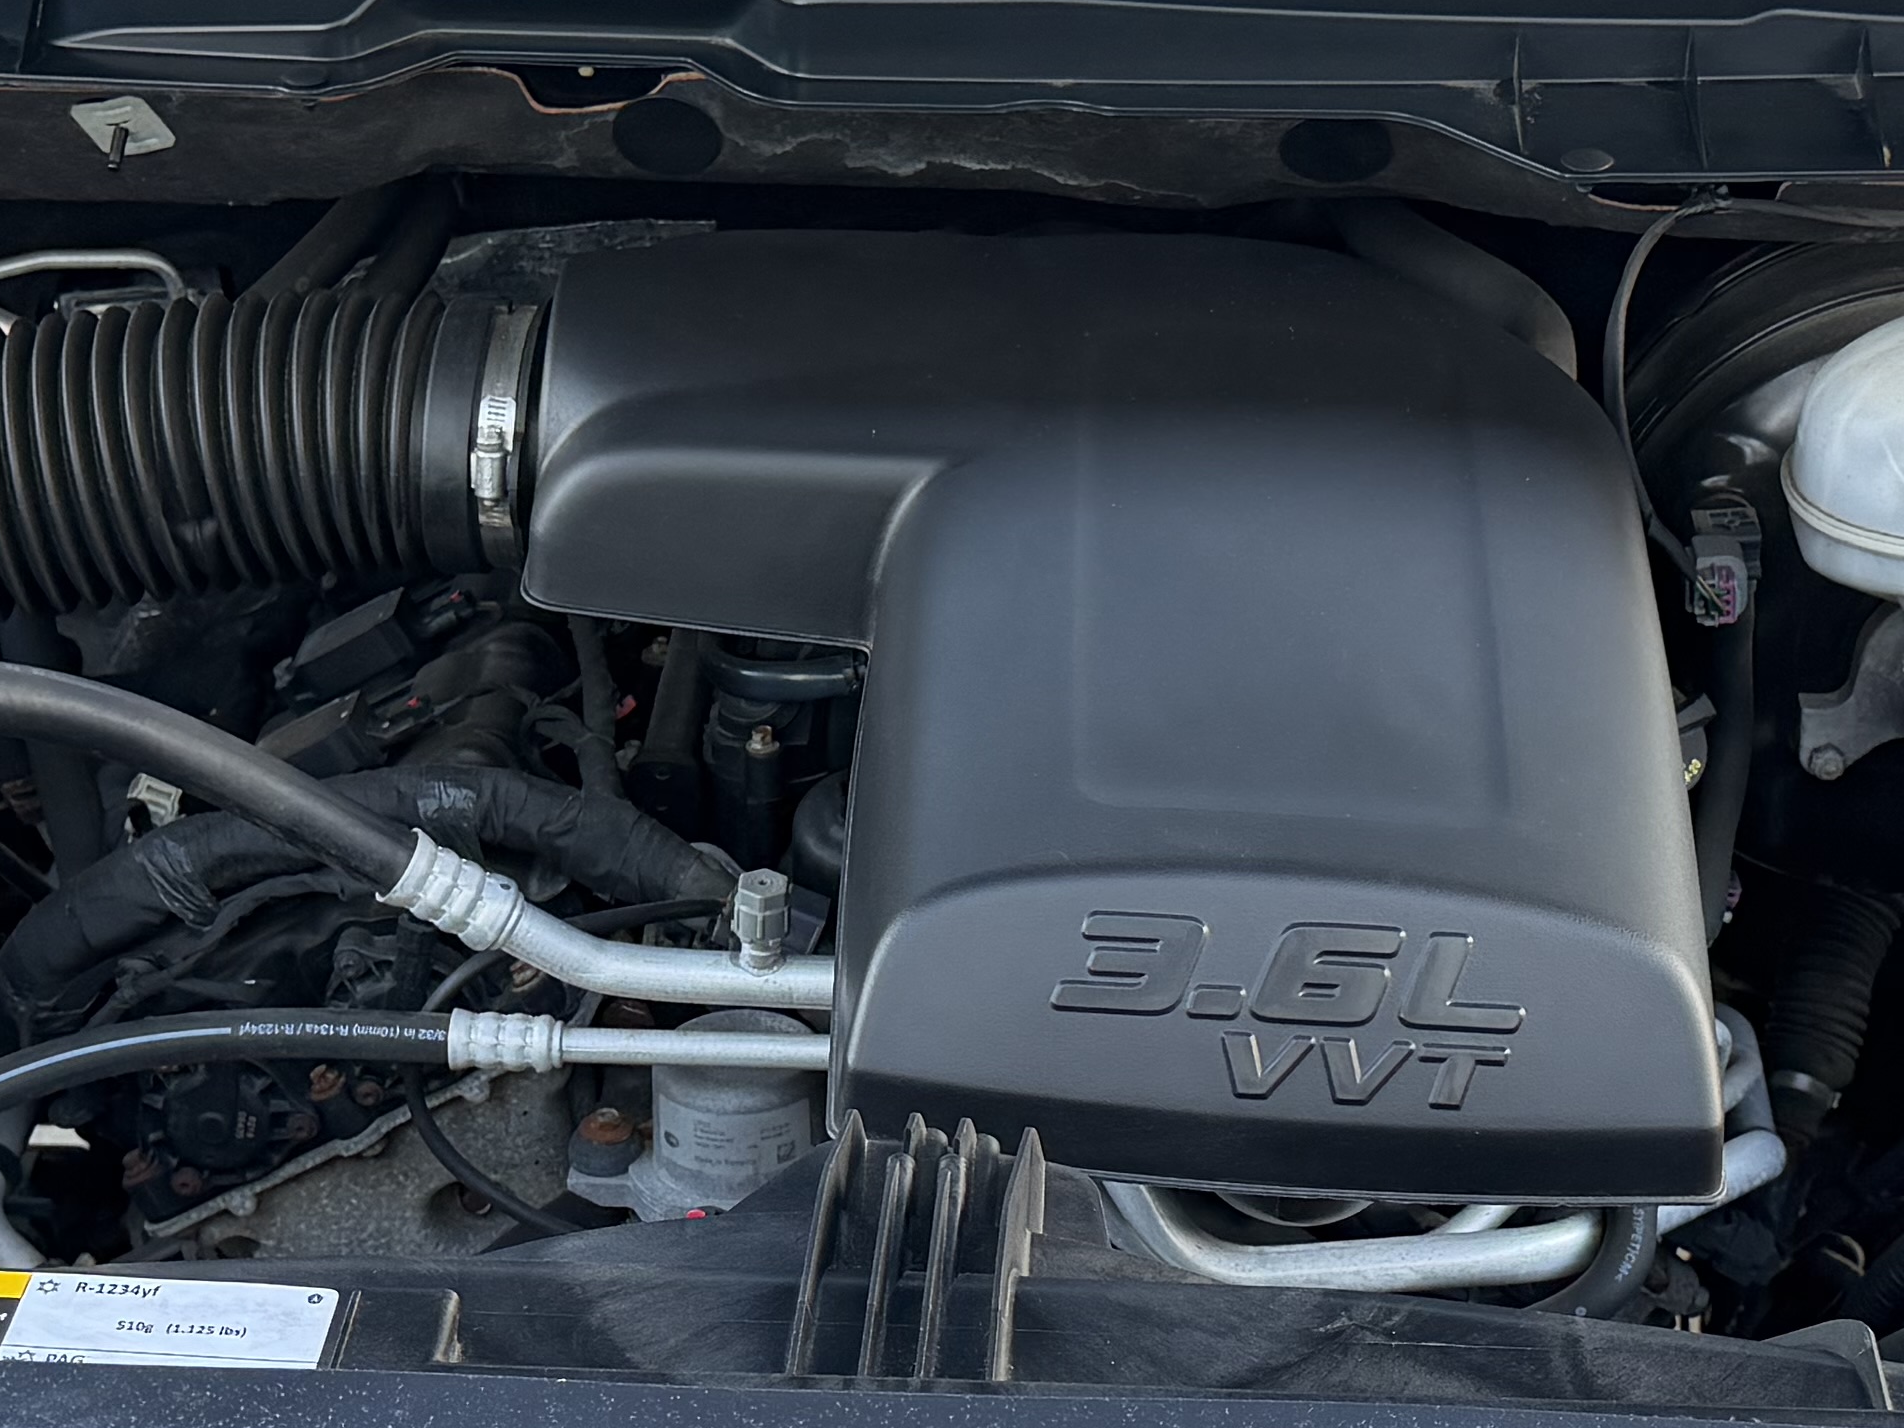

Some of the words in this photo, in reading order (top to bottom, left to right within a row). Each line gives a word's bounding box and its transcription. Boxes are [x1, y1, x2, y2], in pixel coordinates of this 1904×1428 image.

[1050, 909, 1528, 1033] 3.6L
[304, 1022, 350, 1037] R-134a
[352, 1022, 401, 1039] (10mm)
[1219, 1030, 1512, 1111] VVT
[74, 1280, 163, 1299] R-1234yf
[165, 1321, 216, 1338] (1.125
